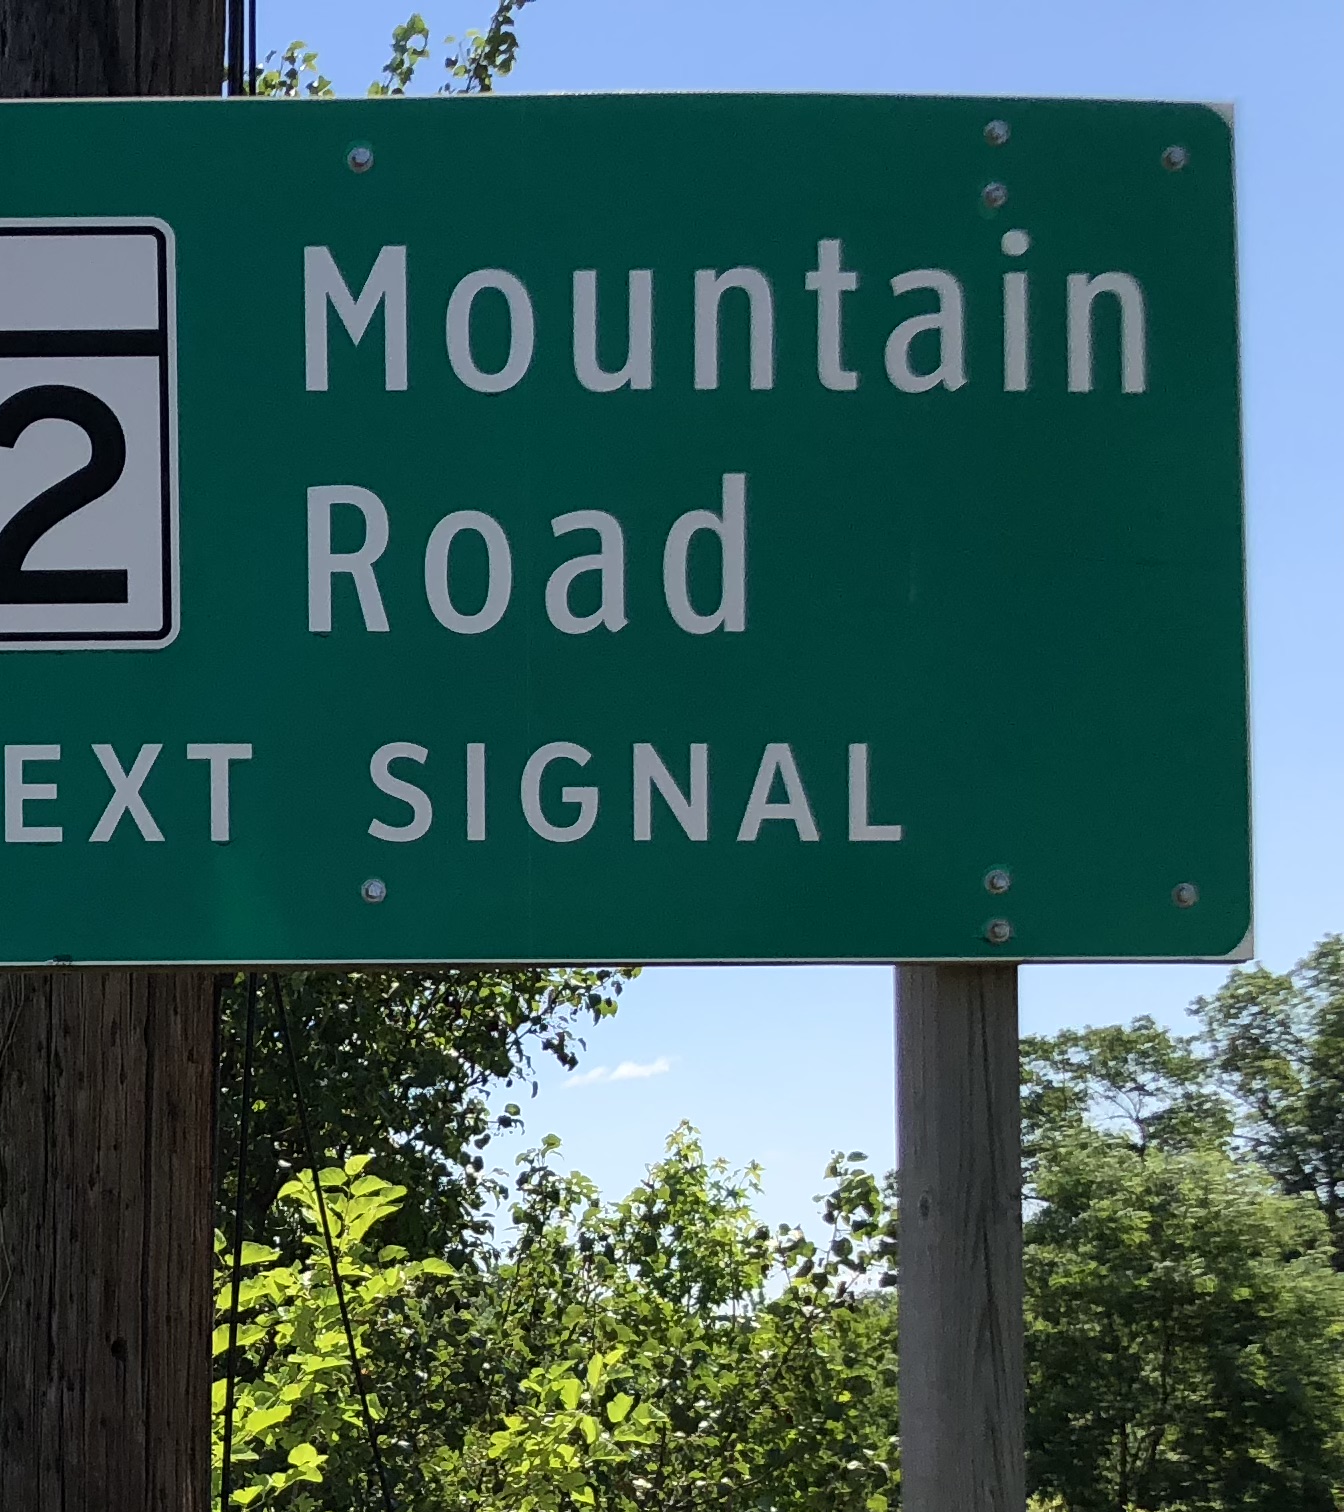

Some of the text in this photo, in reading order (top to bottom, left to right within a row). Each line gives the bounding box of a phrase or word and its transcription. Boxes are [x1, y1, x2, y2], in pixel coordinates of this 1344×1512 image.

[303, 230, 1147, 394] Mountain
[306, 473, 747, 635] Road
[367, 740, 903, 843] SIGNAL
